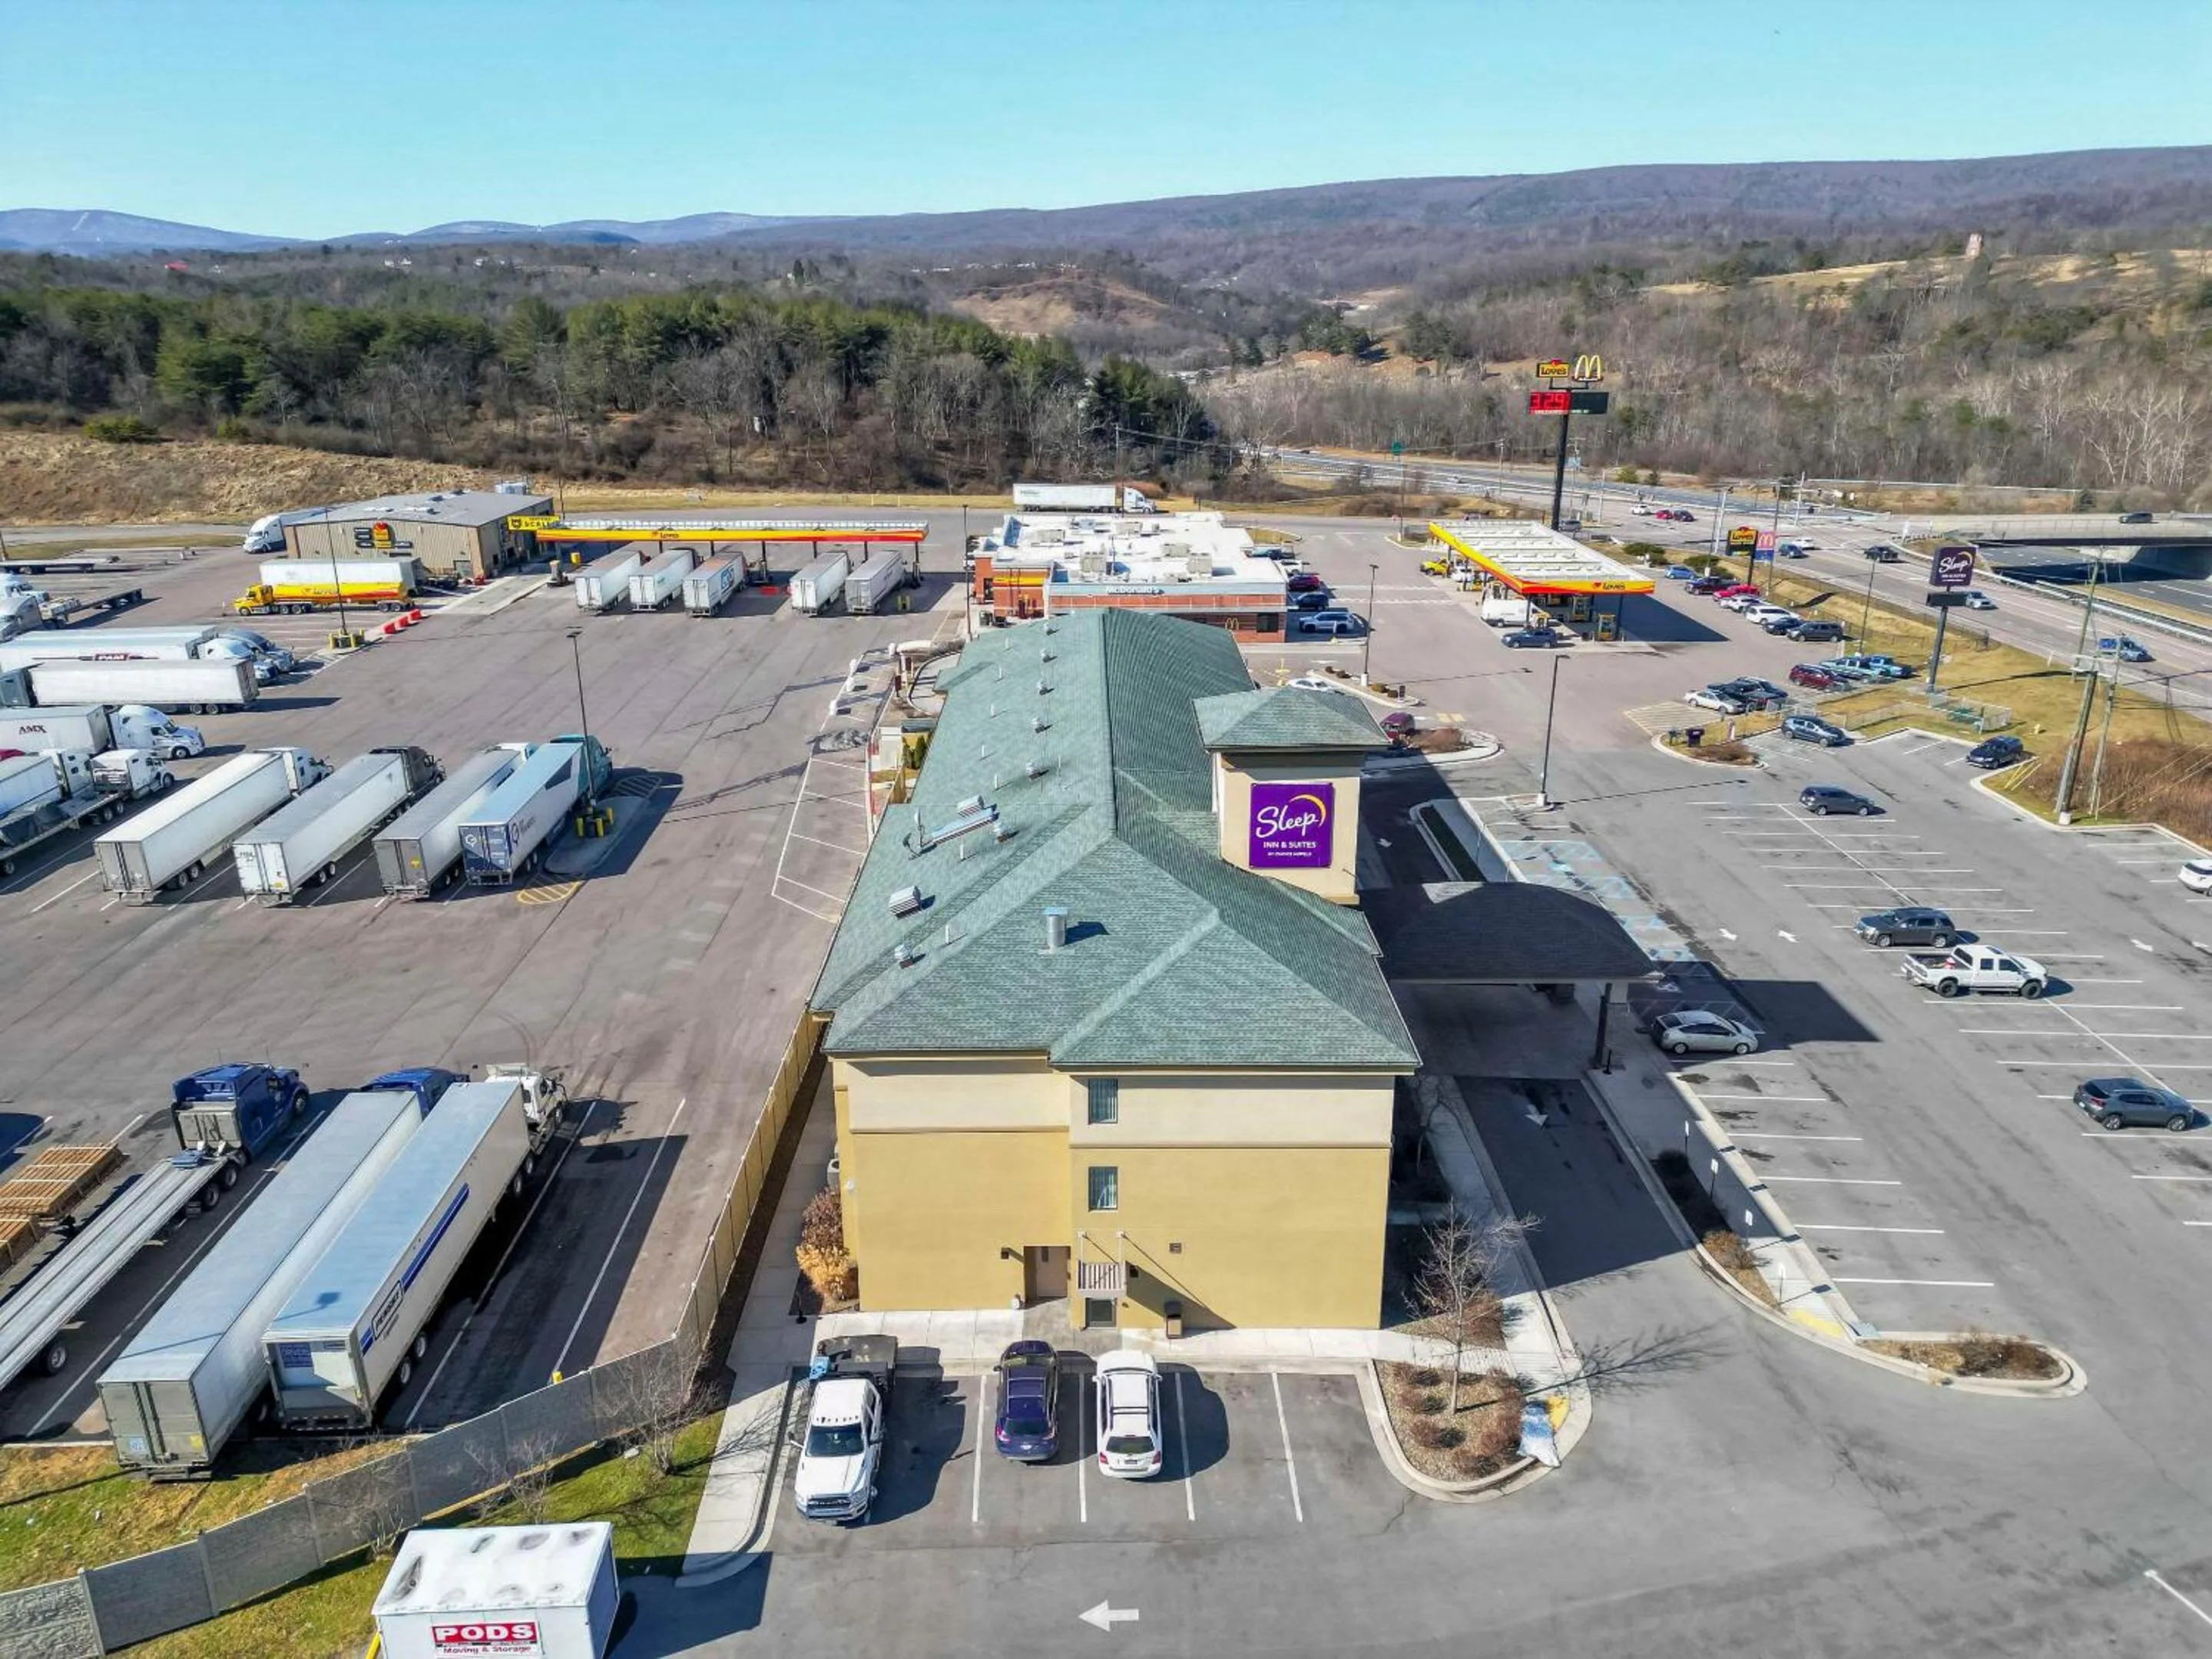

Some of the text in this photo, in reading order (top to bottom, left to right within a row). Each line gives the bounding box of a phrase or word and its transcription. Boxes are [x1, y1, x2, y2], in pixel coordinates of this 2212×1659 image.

[1939, 557, 1969, 573] Sleep
[18, 725, 48, 735] AMX
[1256, 805, 1320, 838] Sleep
[434, 1624, 534, 1641] PODS
[492, 1645, 531, 1654] Storage
